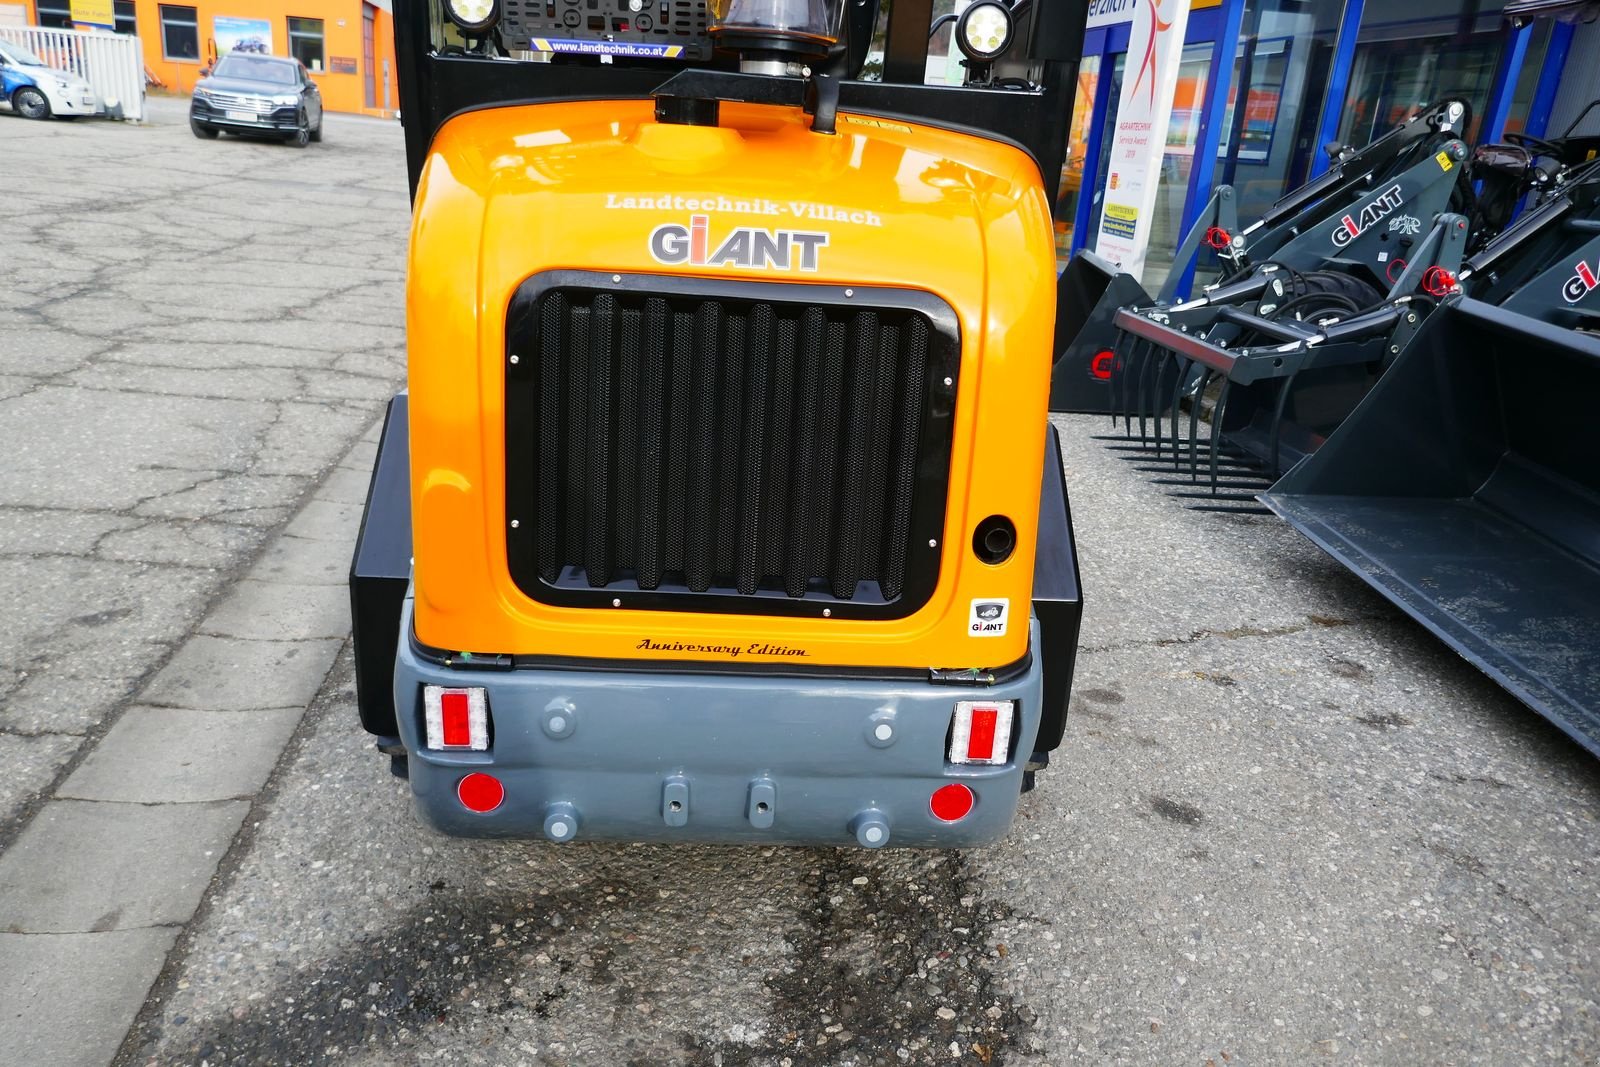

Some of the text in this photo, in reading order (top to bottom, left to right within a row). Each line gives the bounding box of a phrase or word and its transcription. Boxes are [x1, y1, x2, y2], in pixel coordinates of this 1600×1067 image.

[552, 42, 662, 56] www.landtechnik.co.at
[1119, 122, 1152, 131] AGRARTECHNIK
[1119, 136, 1148, 145] Service Award
[605, 194, 883, 226] Landtechnik-Villach
[636, 639, 810, 657] Anniversary Edition
